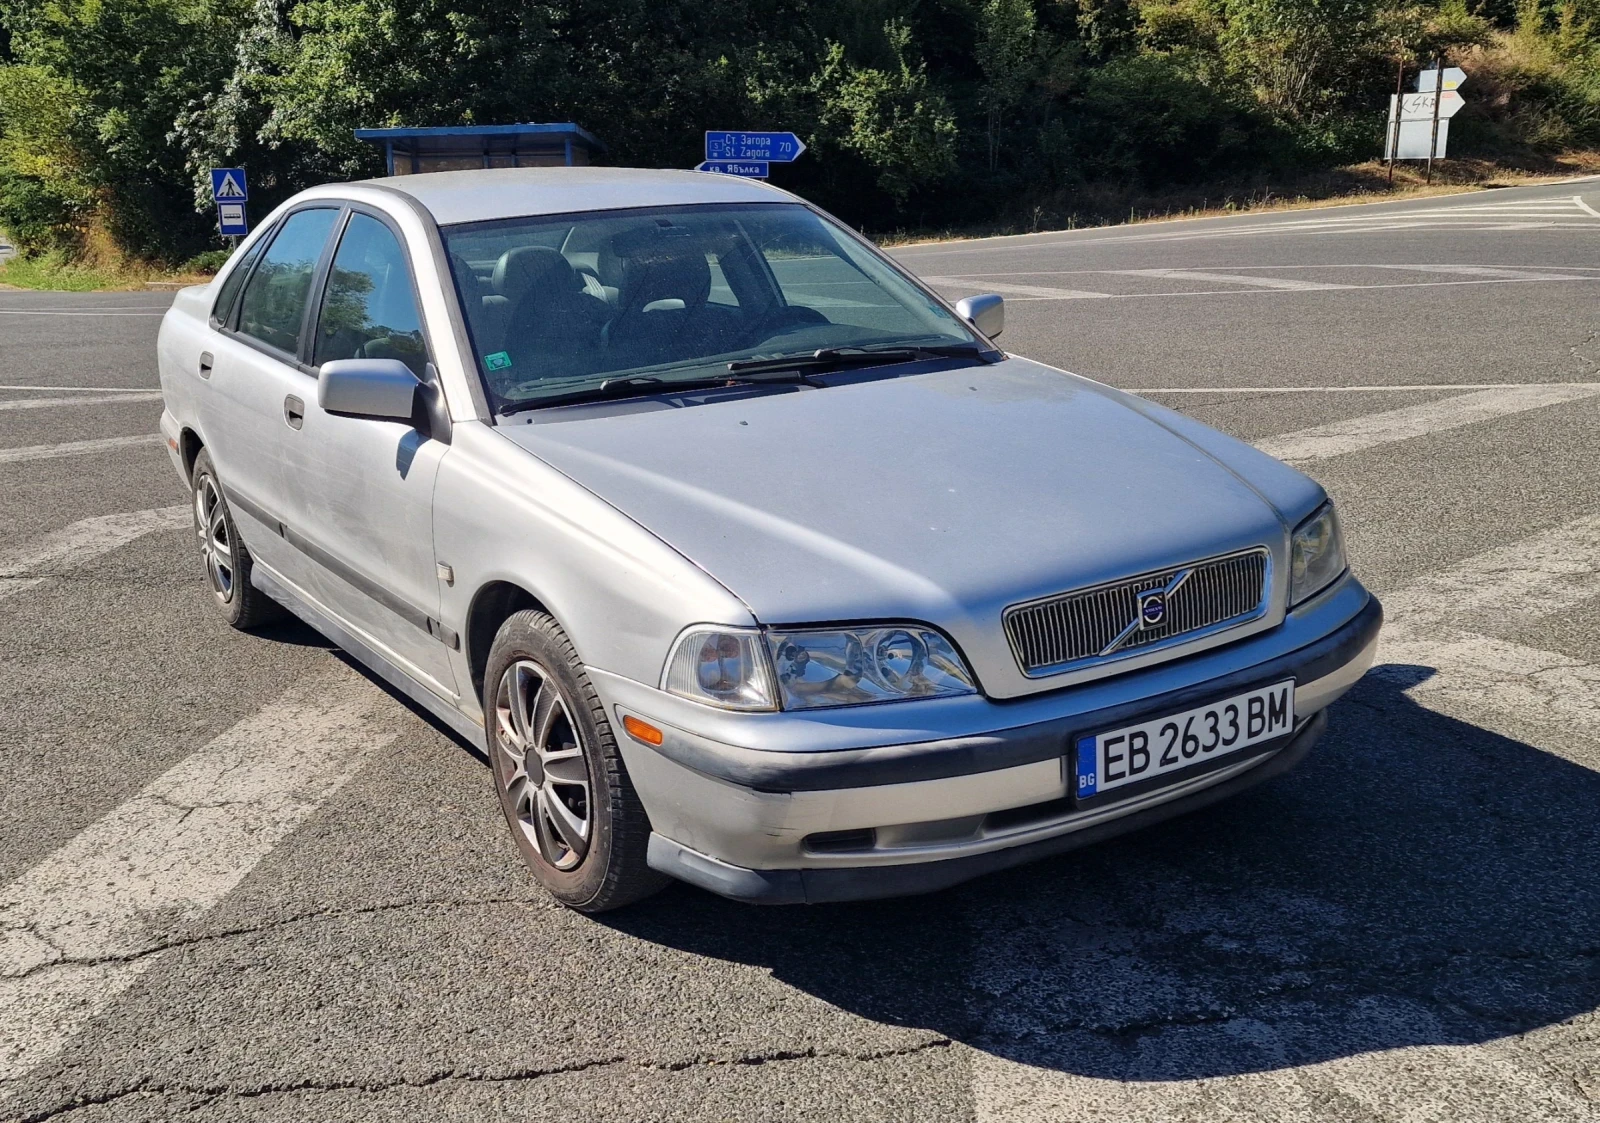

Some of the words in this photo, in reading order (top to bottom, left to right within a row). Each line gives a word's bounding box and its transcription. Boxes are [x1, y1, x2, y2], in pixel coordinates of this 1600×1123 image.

[725, 134, 738, 145] Ст.
[741, 134, 771, 147] Загора
[779, 142, 792, 152] 70
[725, 146, 737, 157] St.
[740, 147, 770, 160] Zagora
[727, 164, 760, 174] Ябълка
[1103, 731, 1150, 783] EB
[1159, 704, 1240, 768] 2633
[1247, 687, 1288, 740] BM
[1079, 772, 1095, 789] BG
